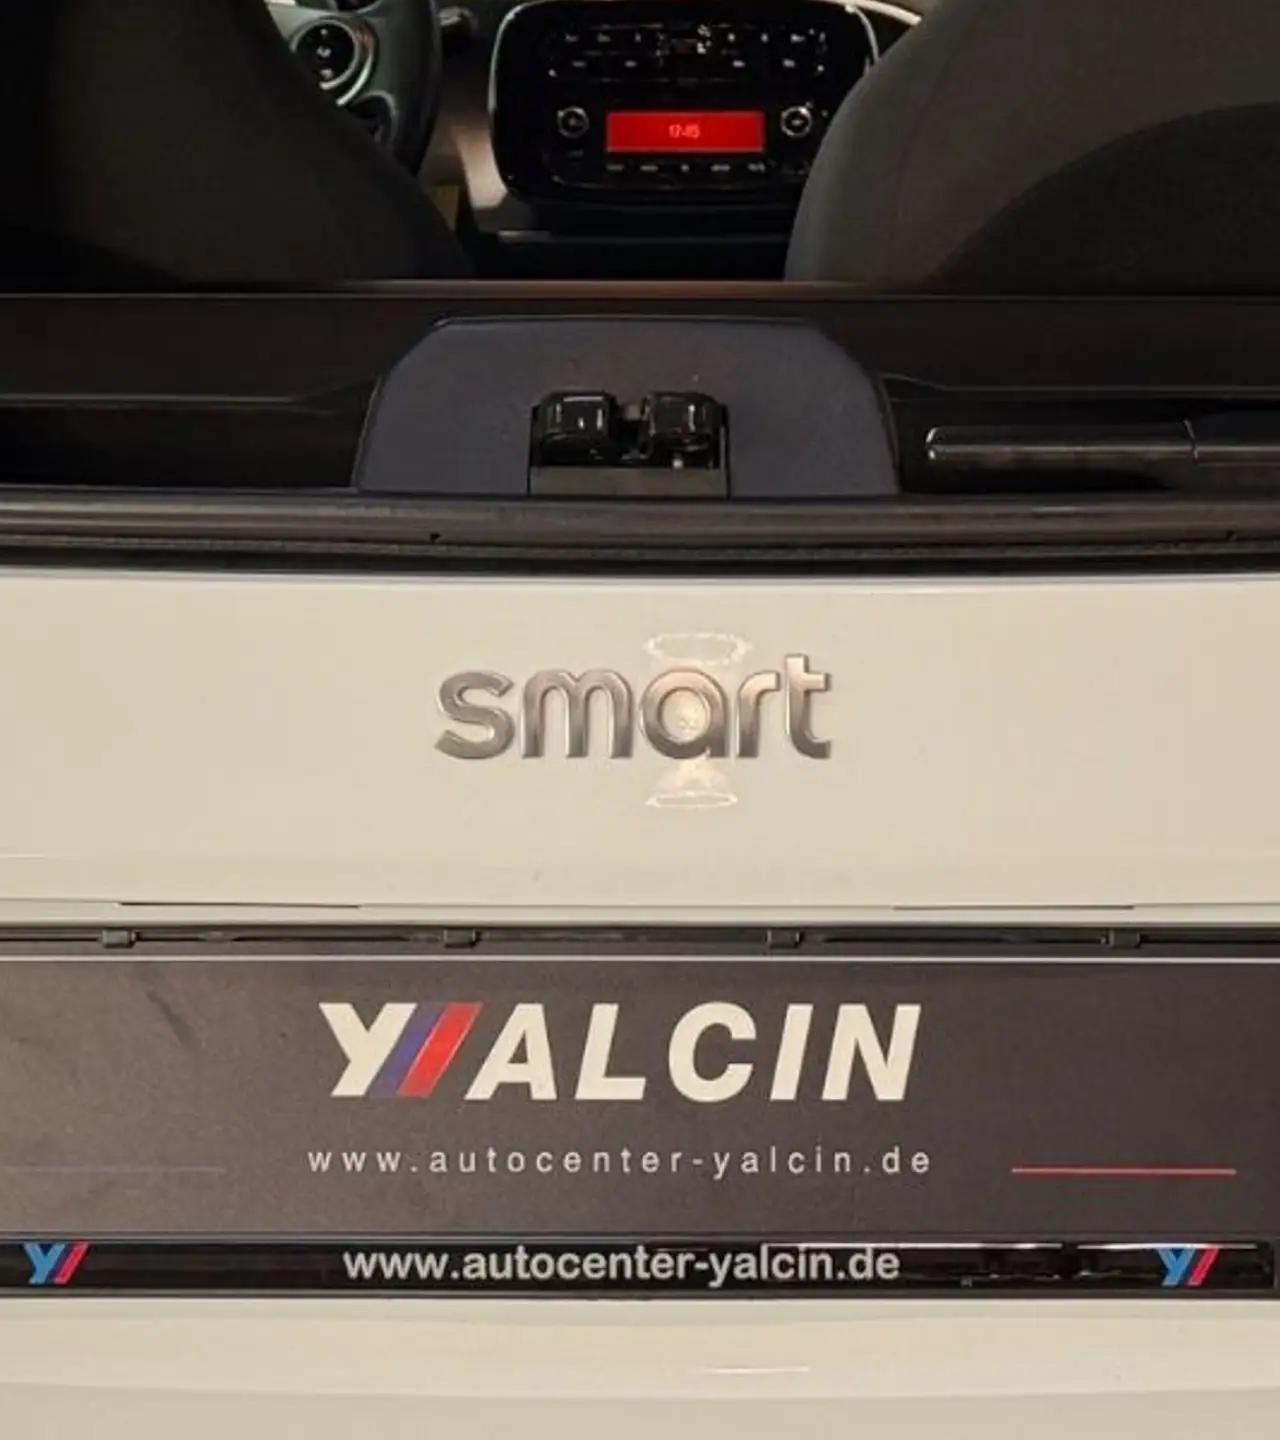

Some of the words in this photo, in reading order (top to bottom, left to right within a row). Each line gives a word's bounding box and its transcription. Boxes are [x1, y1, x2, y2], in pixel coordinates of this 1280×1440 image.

[433, 653, 832, 760] smart
[308, 1145, 931, 1181] www.autocenter-yalcin.de
[342, 1244, 901, 1288] www.autocenter-yalcin.de
